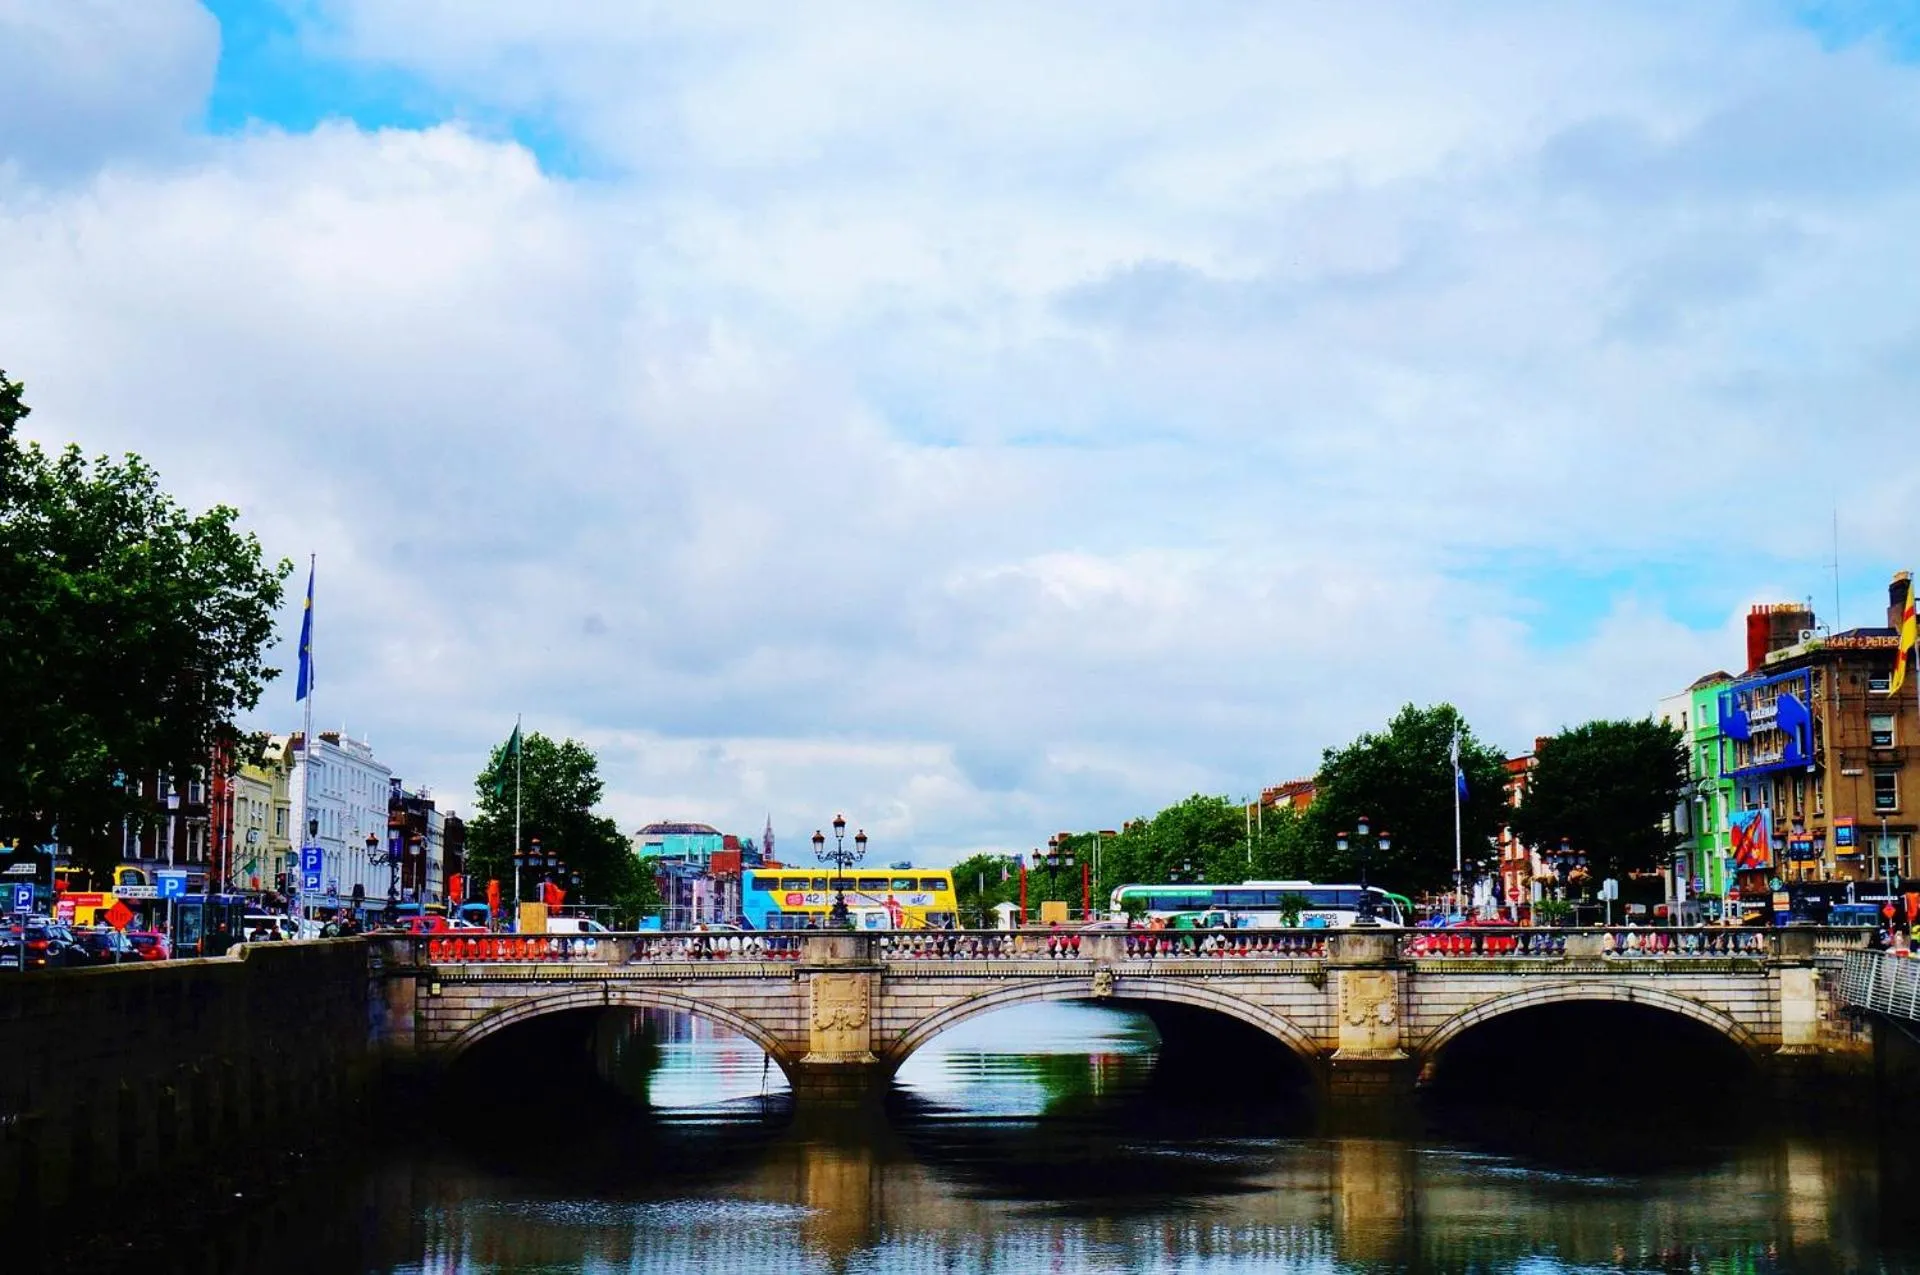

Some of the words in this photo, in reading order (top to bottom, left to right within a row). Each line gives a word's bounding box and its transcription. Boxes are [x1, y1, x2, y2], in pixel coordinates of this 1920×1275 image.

[306, 855, 317, 869] P
[165, 879, 179, 896] P
[307, 877, 318, 888] P
[18, 891, 30, 905] P
